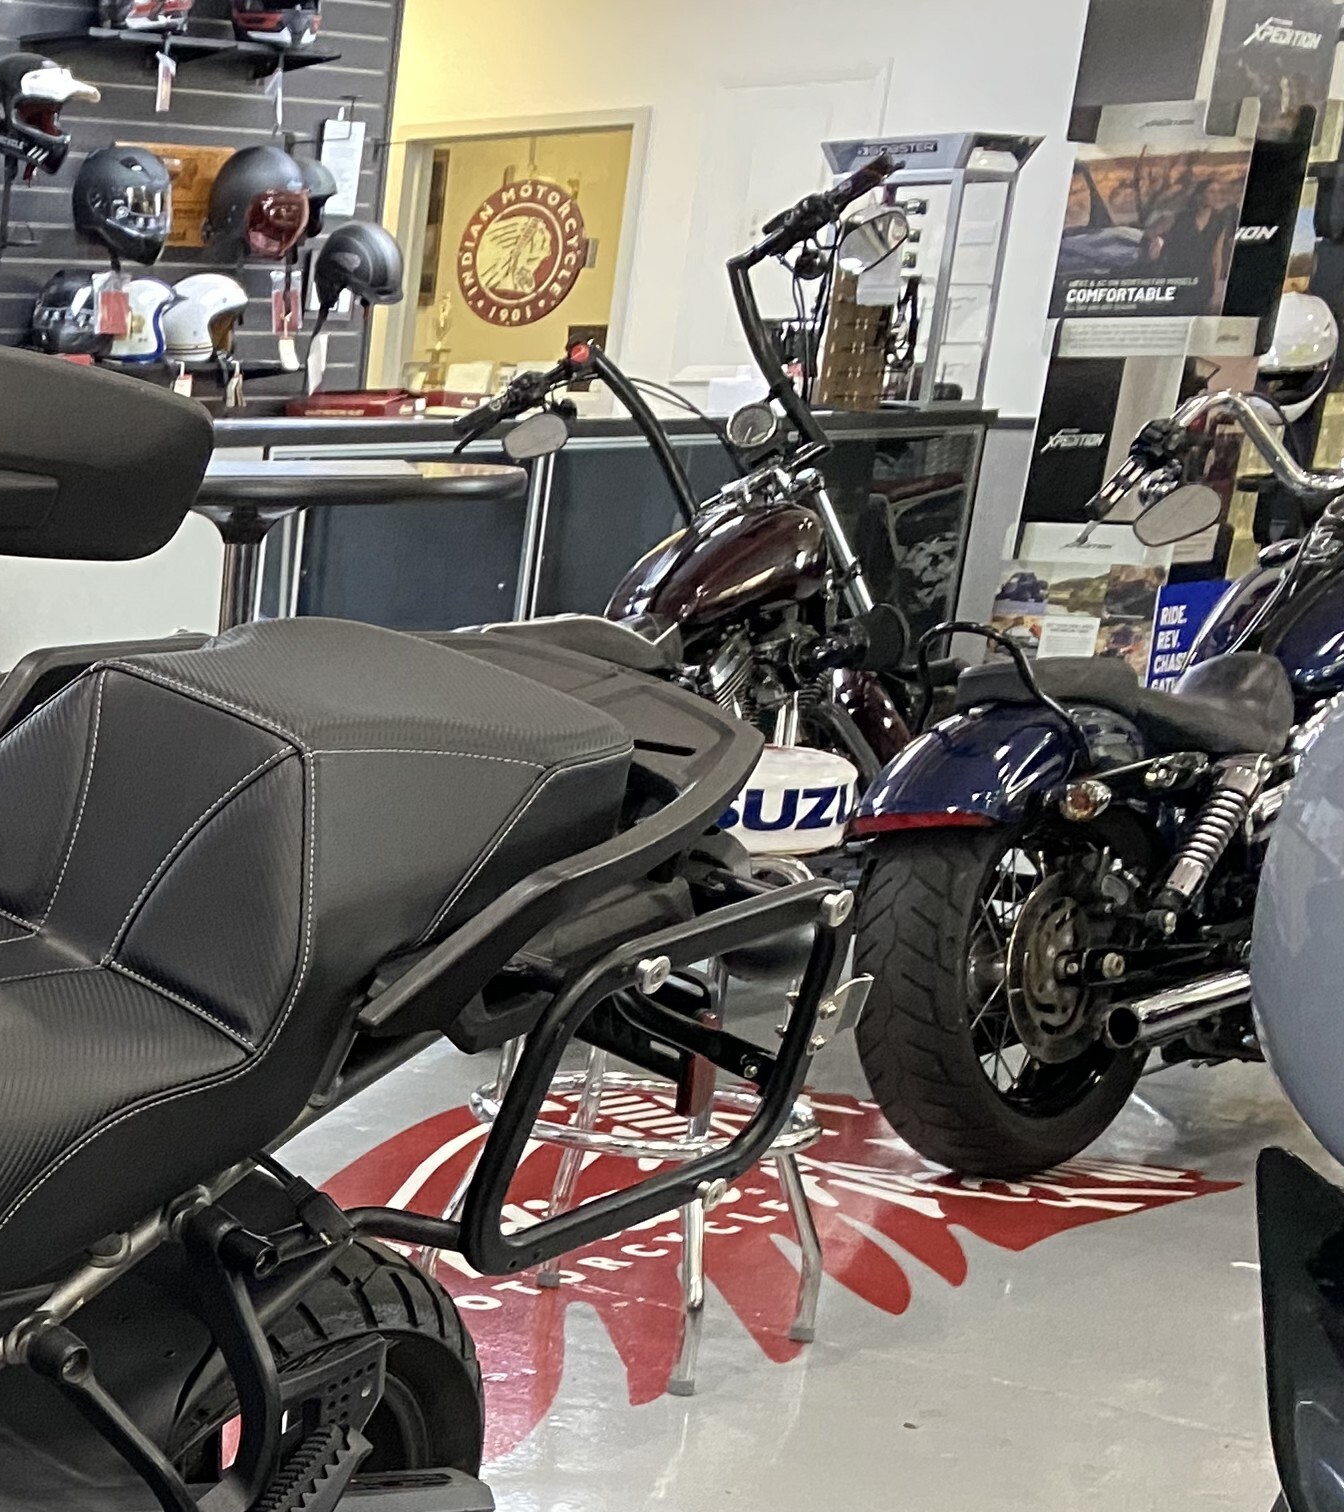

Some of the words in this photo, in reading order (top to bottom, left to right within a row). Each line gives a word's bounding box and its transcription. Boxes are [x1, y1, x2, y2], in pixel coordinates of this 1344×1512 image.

[461, 203, 495, 298] INDIAN
[501, 184, 580, 297] MOTORCYCLE
[1065, 286, 1177, 303] COMFORTABLE
[488, 306, 532, 321] 1901
[1160, 604, 1187, 624] RIDE.
[1156, 630, 1181, 650] REV.
[1153, 653, 1187, 673] CHAS
[454, 1198, 790, 1310] OTORCYCLE
